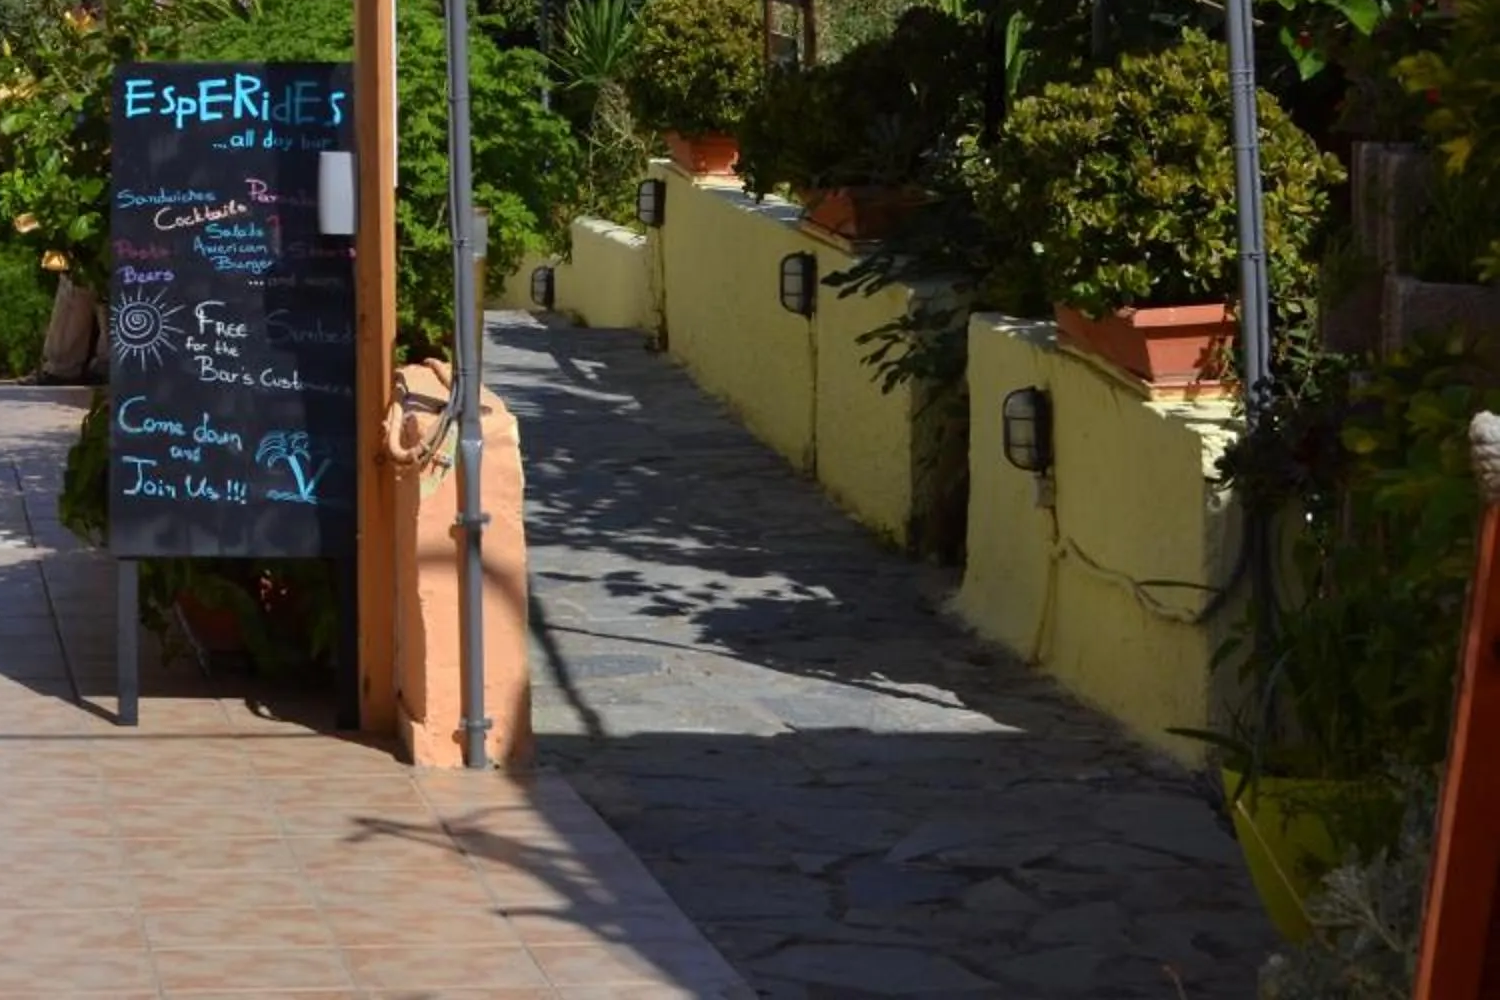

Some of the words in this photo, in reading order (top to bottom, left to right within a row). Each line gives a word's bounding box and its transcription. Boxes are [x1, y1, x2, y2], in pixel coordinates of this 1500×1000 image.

[263, 130, 293, 151] day
[116, 187, 217, 209] Sandwiches
[153, 199, 248, 231] Cocktails
[204, 222, 264, 239] Salads
[193, 236, 268, 256] American
[210, 255, 274, 275] Burger
[185, 336, 208, 351] for
[214, 339, 240, 357] the
[194, 355, 254, 385] Bar's
[118, 395, 187, 436] Come
[193, 412, 243, 452] down
[169, 445, 202, 463] and
[121, 455, 177, 499] Join
